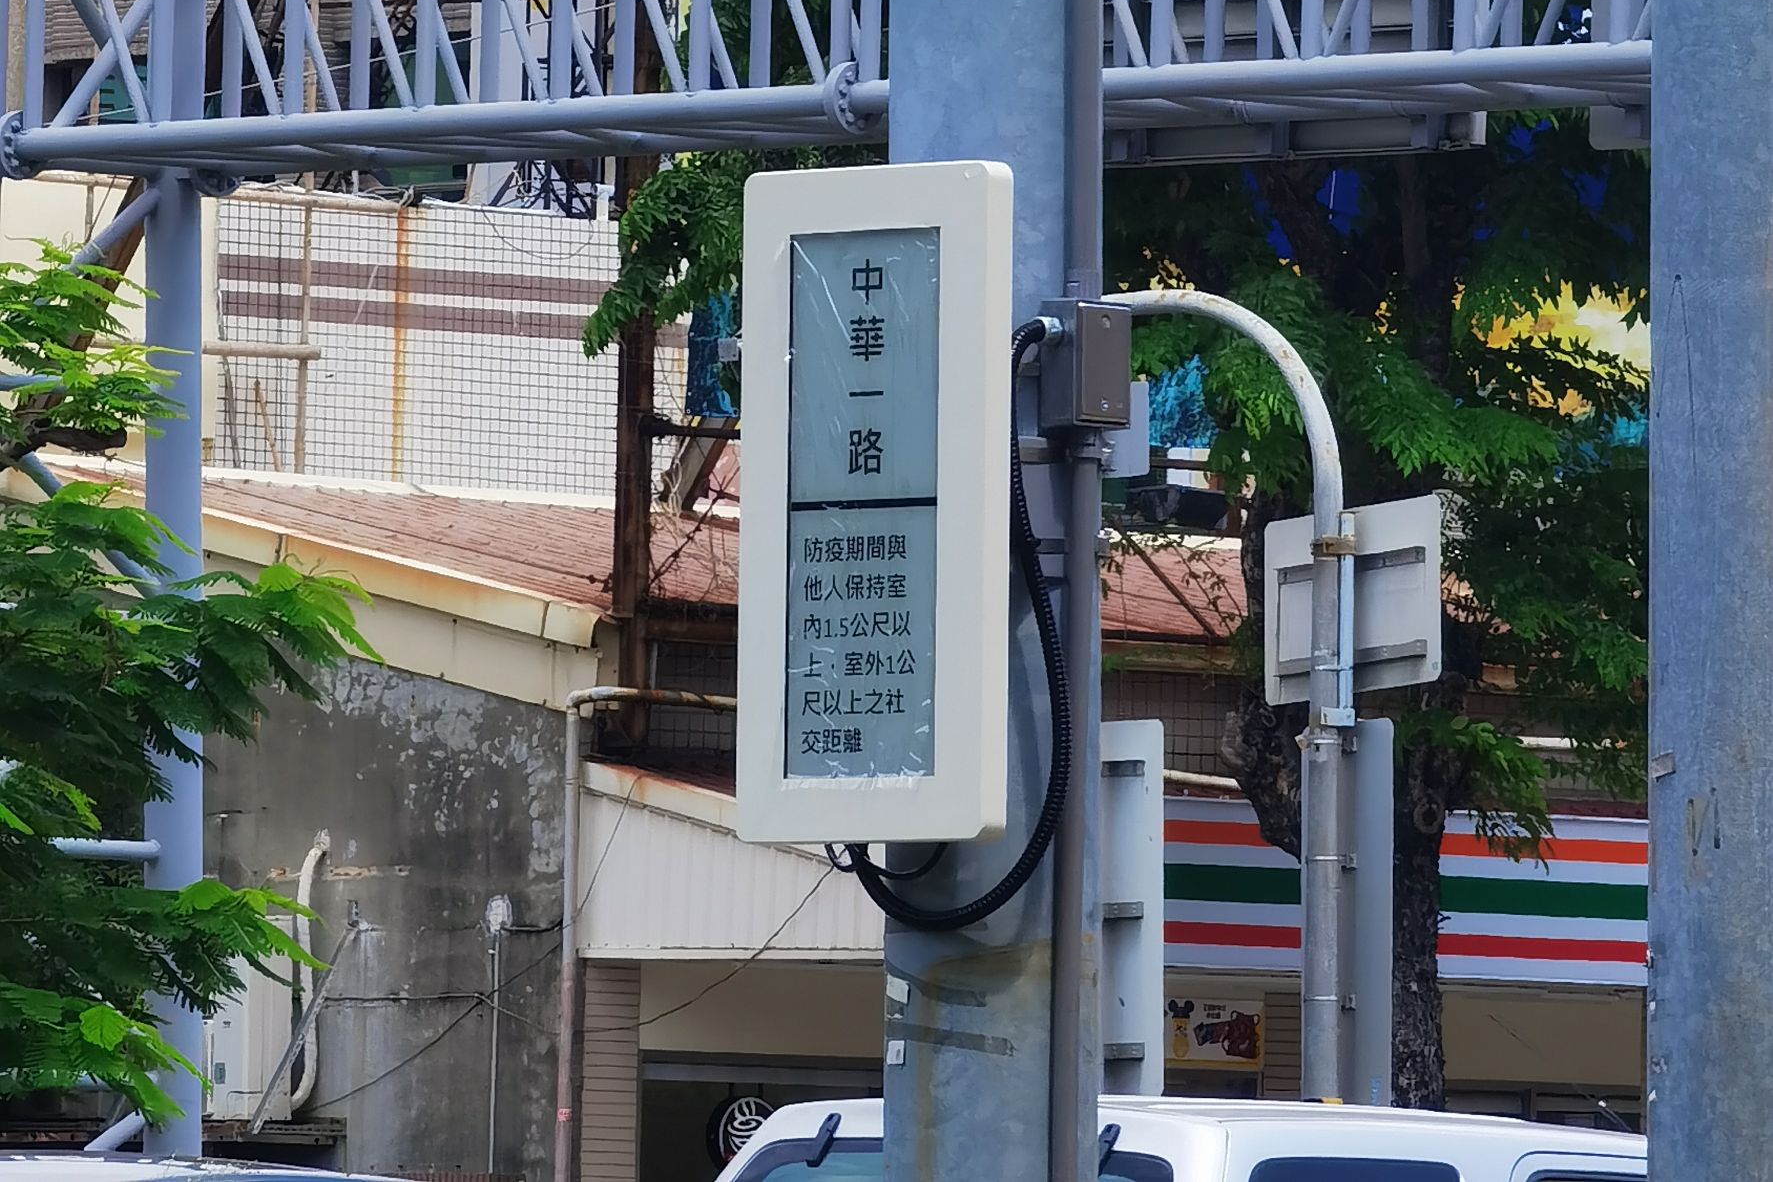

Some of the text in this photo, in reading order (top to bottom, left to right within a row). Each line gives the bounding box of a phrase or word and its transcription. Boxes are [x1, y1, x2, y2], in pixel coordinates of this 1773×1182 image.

[848, 258, 885, 475] 中華一路
[804, 534, 907, 563] 防疫期間與
[804, 573, 907, 602] 他人保持室
[802, 688, 906, 716] 尺以上之社
[801, 727, 863, 754] 交距離
